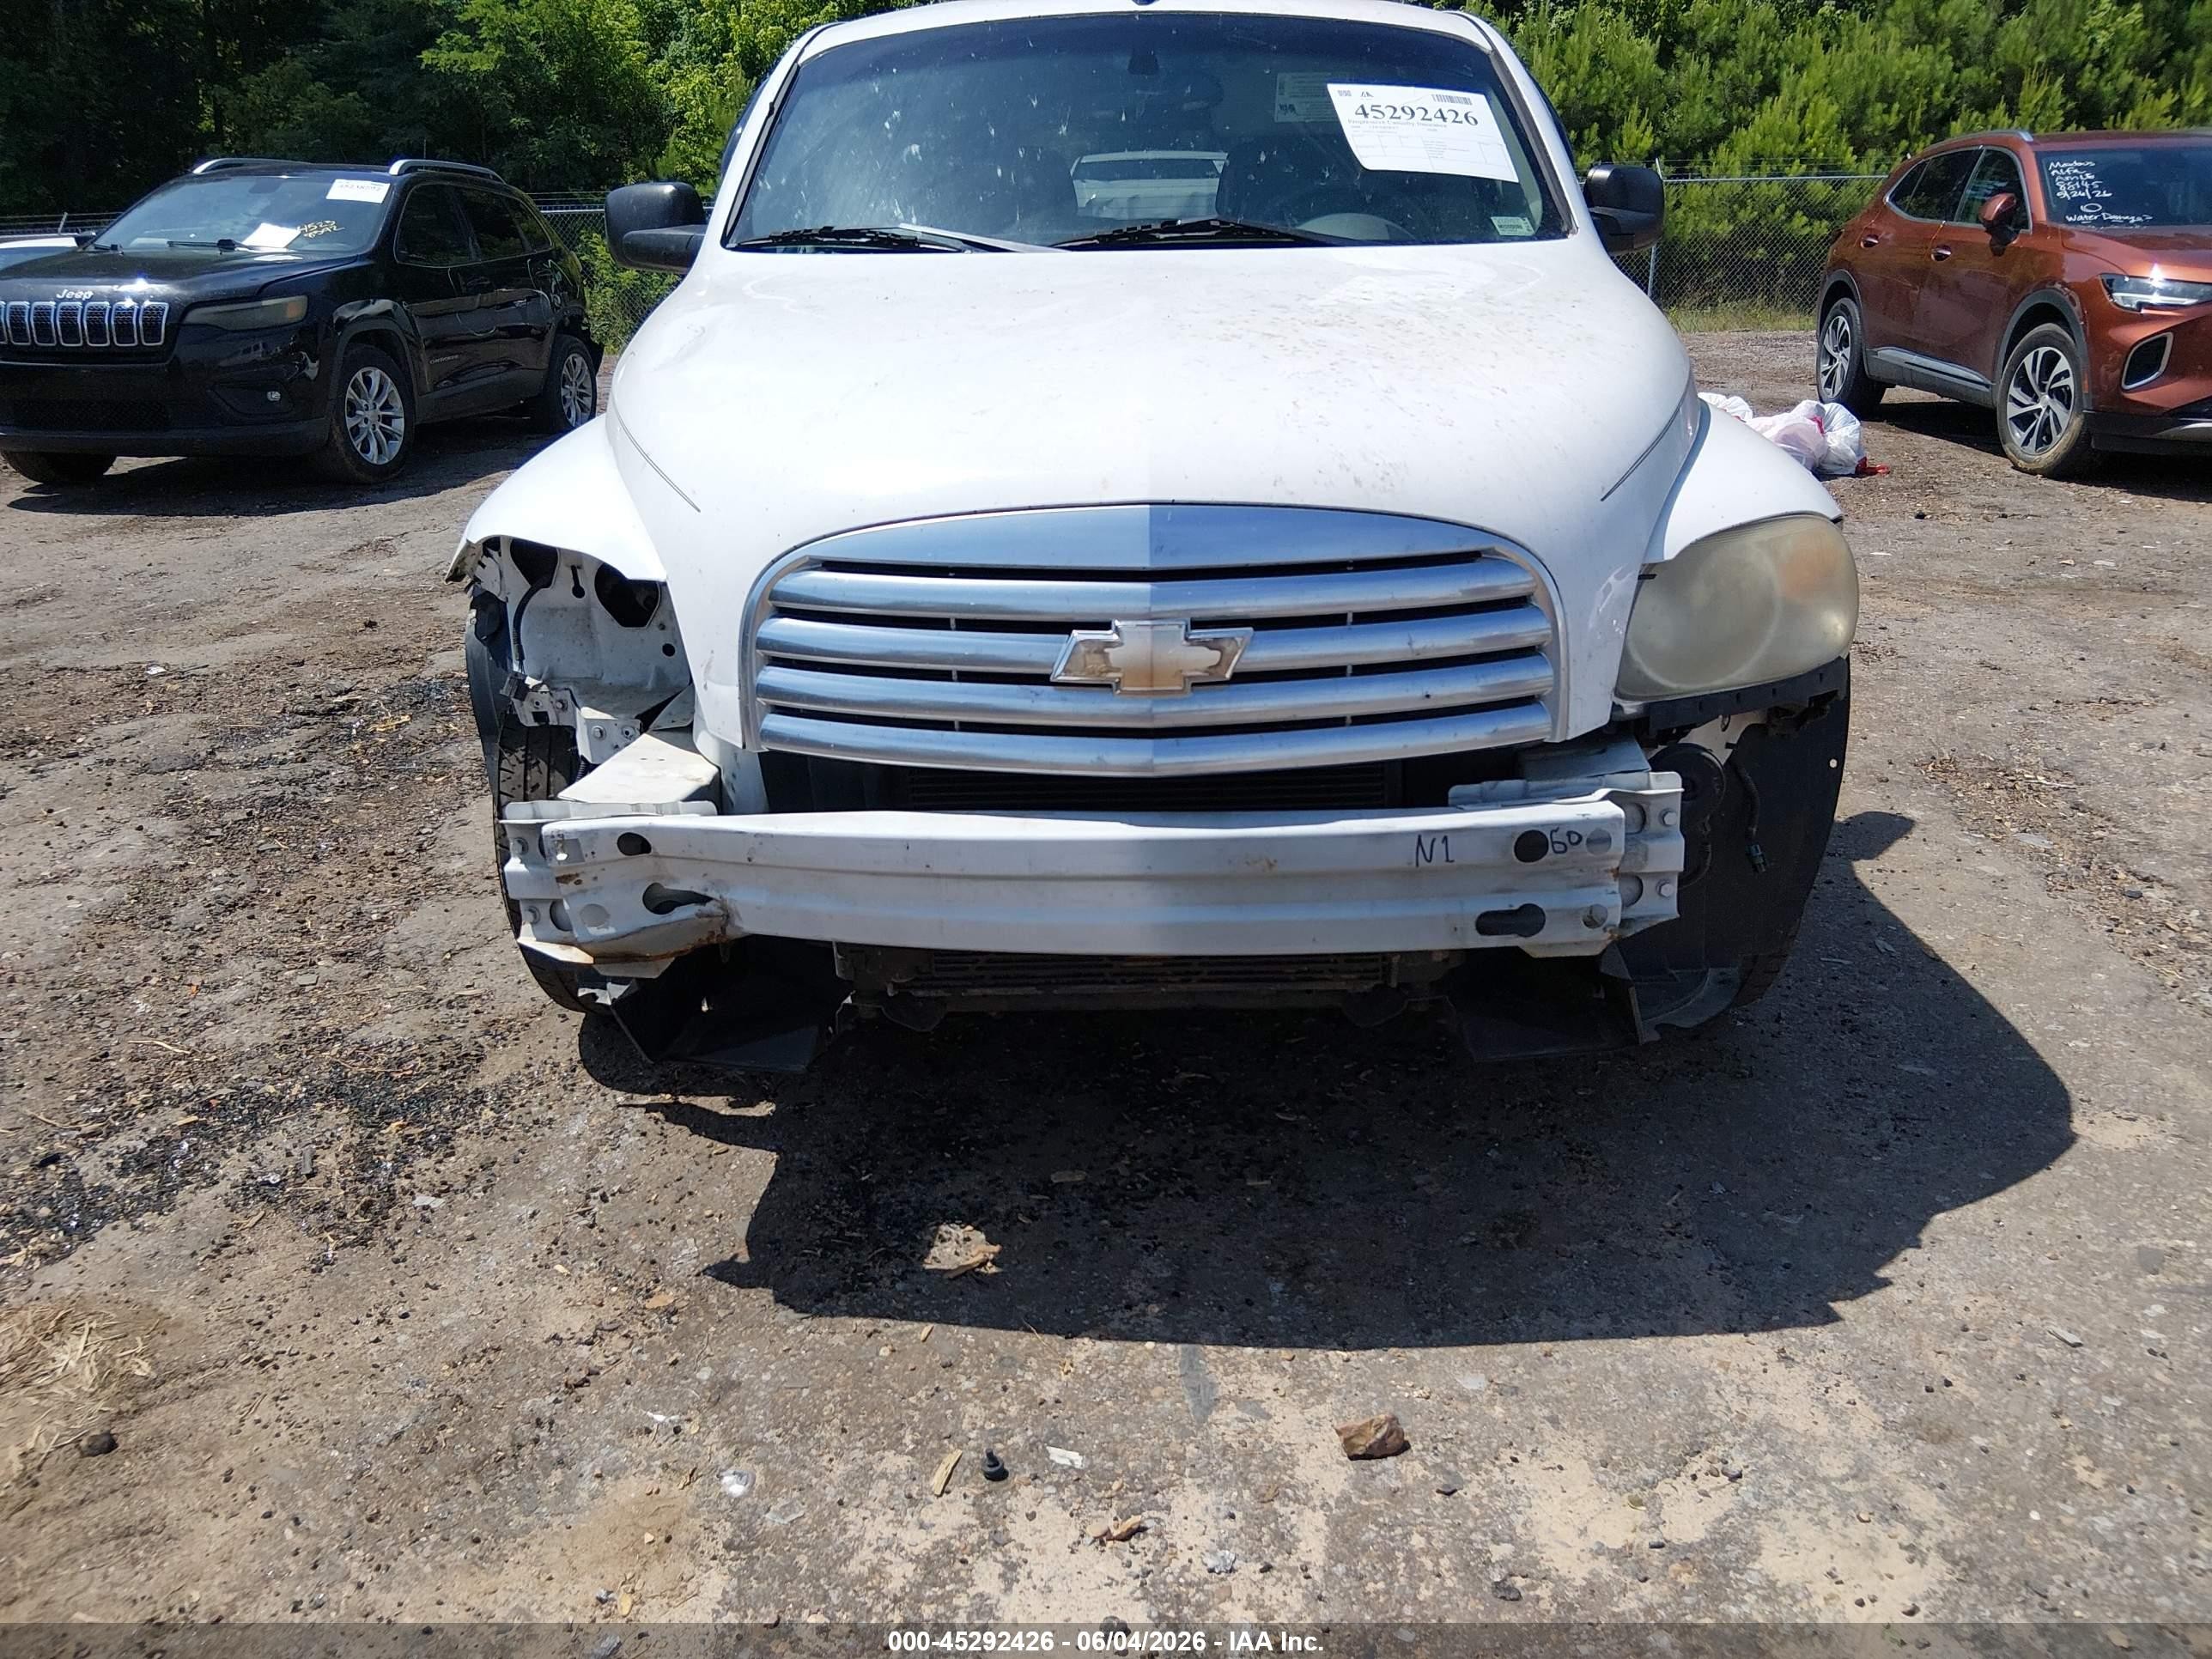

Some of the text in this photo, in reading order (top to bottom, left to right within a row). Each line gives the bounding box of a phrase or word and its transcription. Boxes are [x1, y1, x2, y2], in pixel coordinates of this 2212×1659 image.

[1355, 103, 1478, 125] 45292426
[2065, 214, 2101, 223] Water
[56, 289, 94, 301] Jeep
